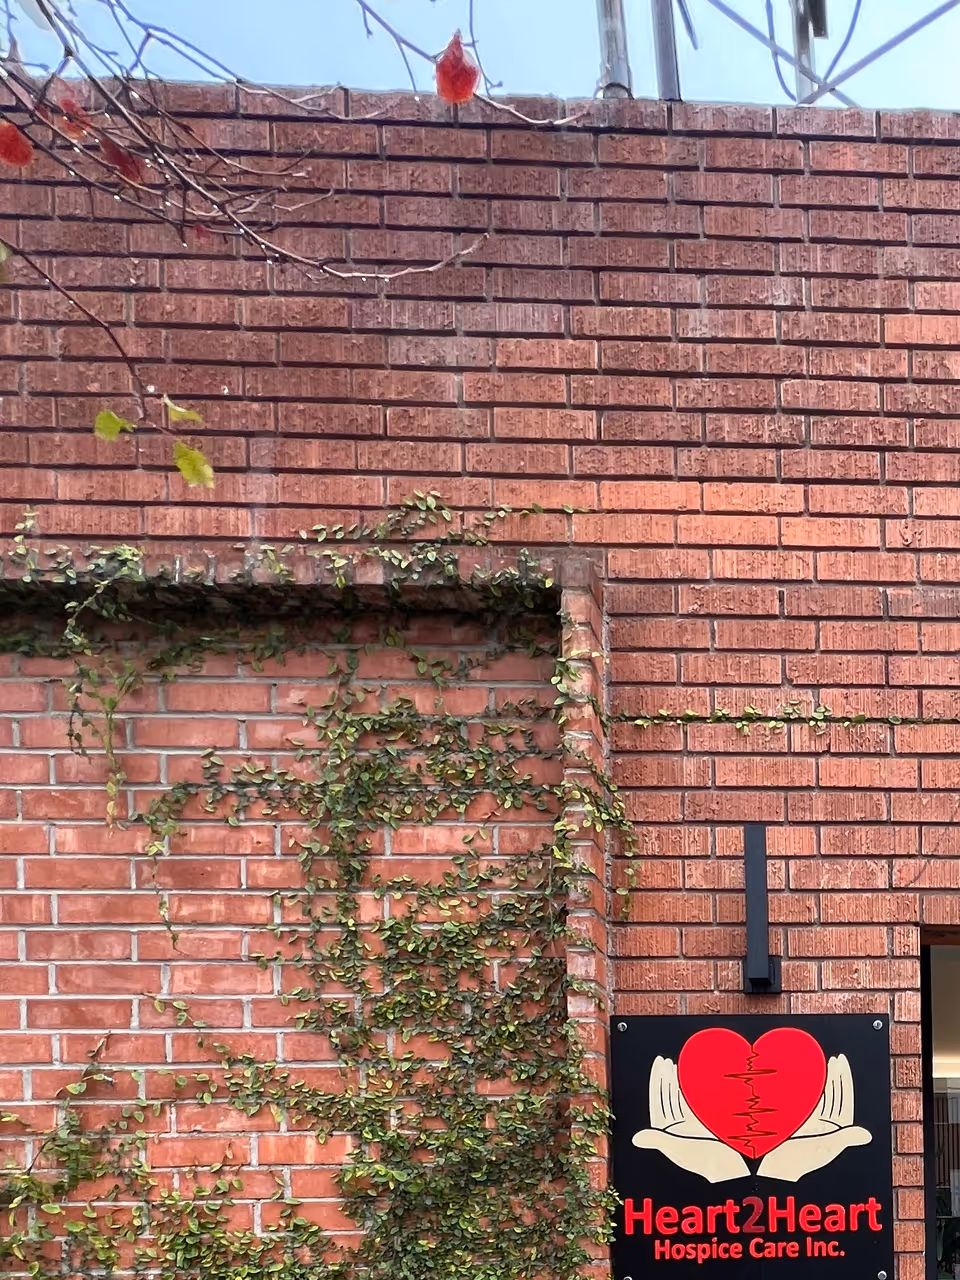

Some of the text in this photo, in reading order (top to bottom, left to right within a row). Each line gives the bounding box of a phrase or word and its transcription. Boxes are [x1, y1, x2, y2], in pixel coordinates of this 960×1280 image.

[624, 1195, 882, 1235] Heart2Heart
[654, 1236, 846, 1264] Hospice Care Inc.
